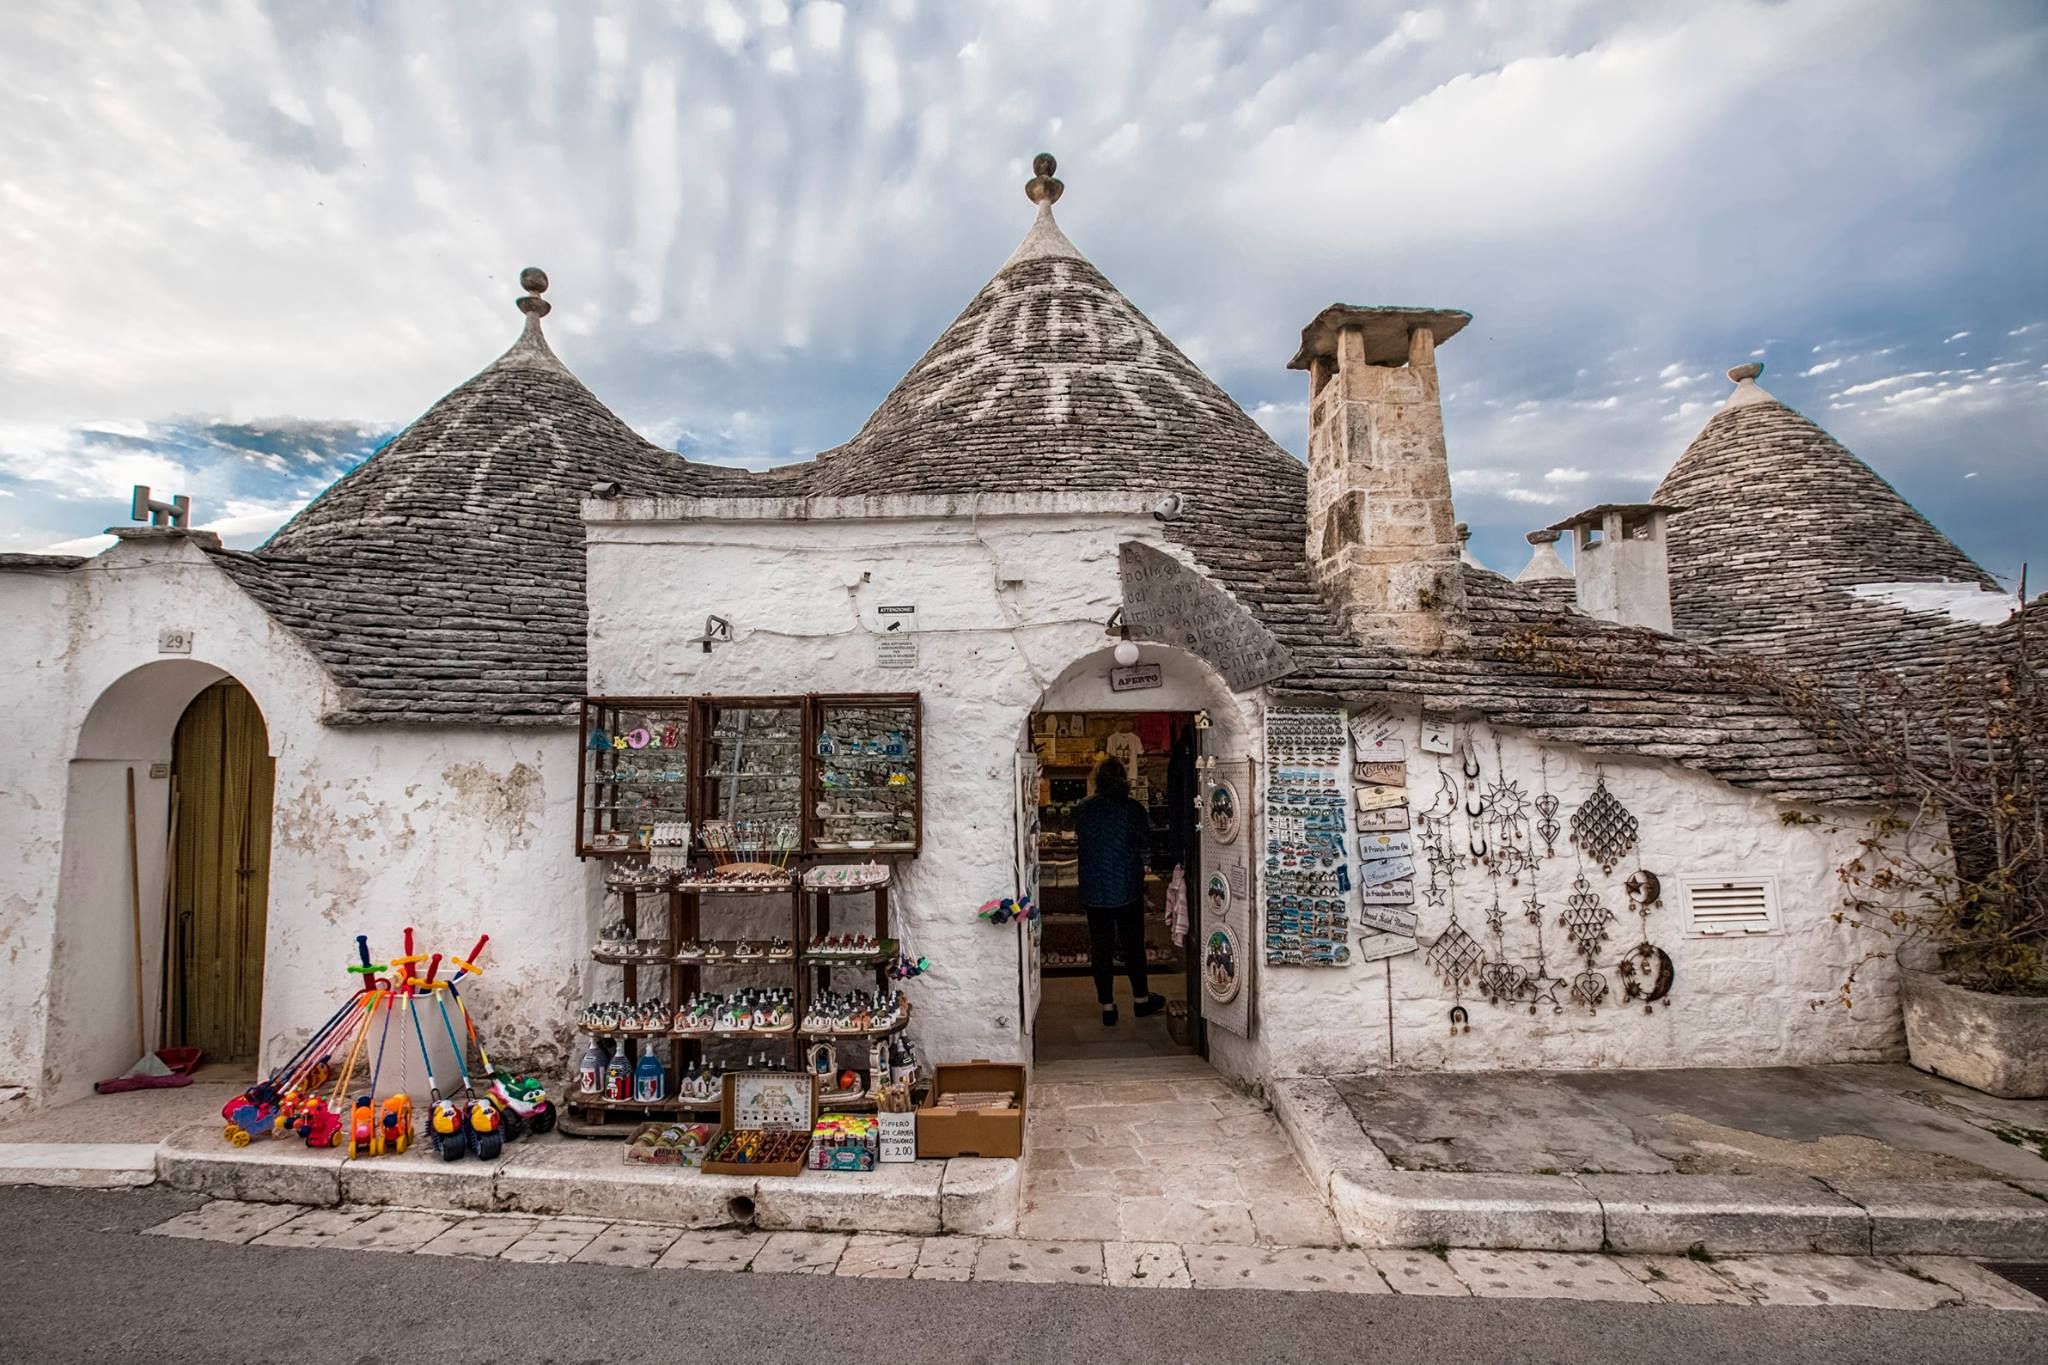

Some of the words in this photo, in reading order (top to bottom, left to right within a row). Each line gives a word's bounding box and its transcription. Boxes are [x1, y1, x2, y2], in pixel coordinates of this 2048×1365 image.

[165, 634, 183, 649] 29
[1118, 674, 1158, 686] APERTO
[881, 1119, 910, 1128] PIFFERO
